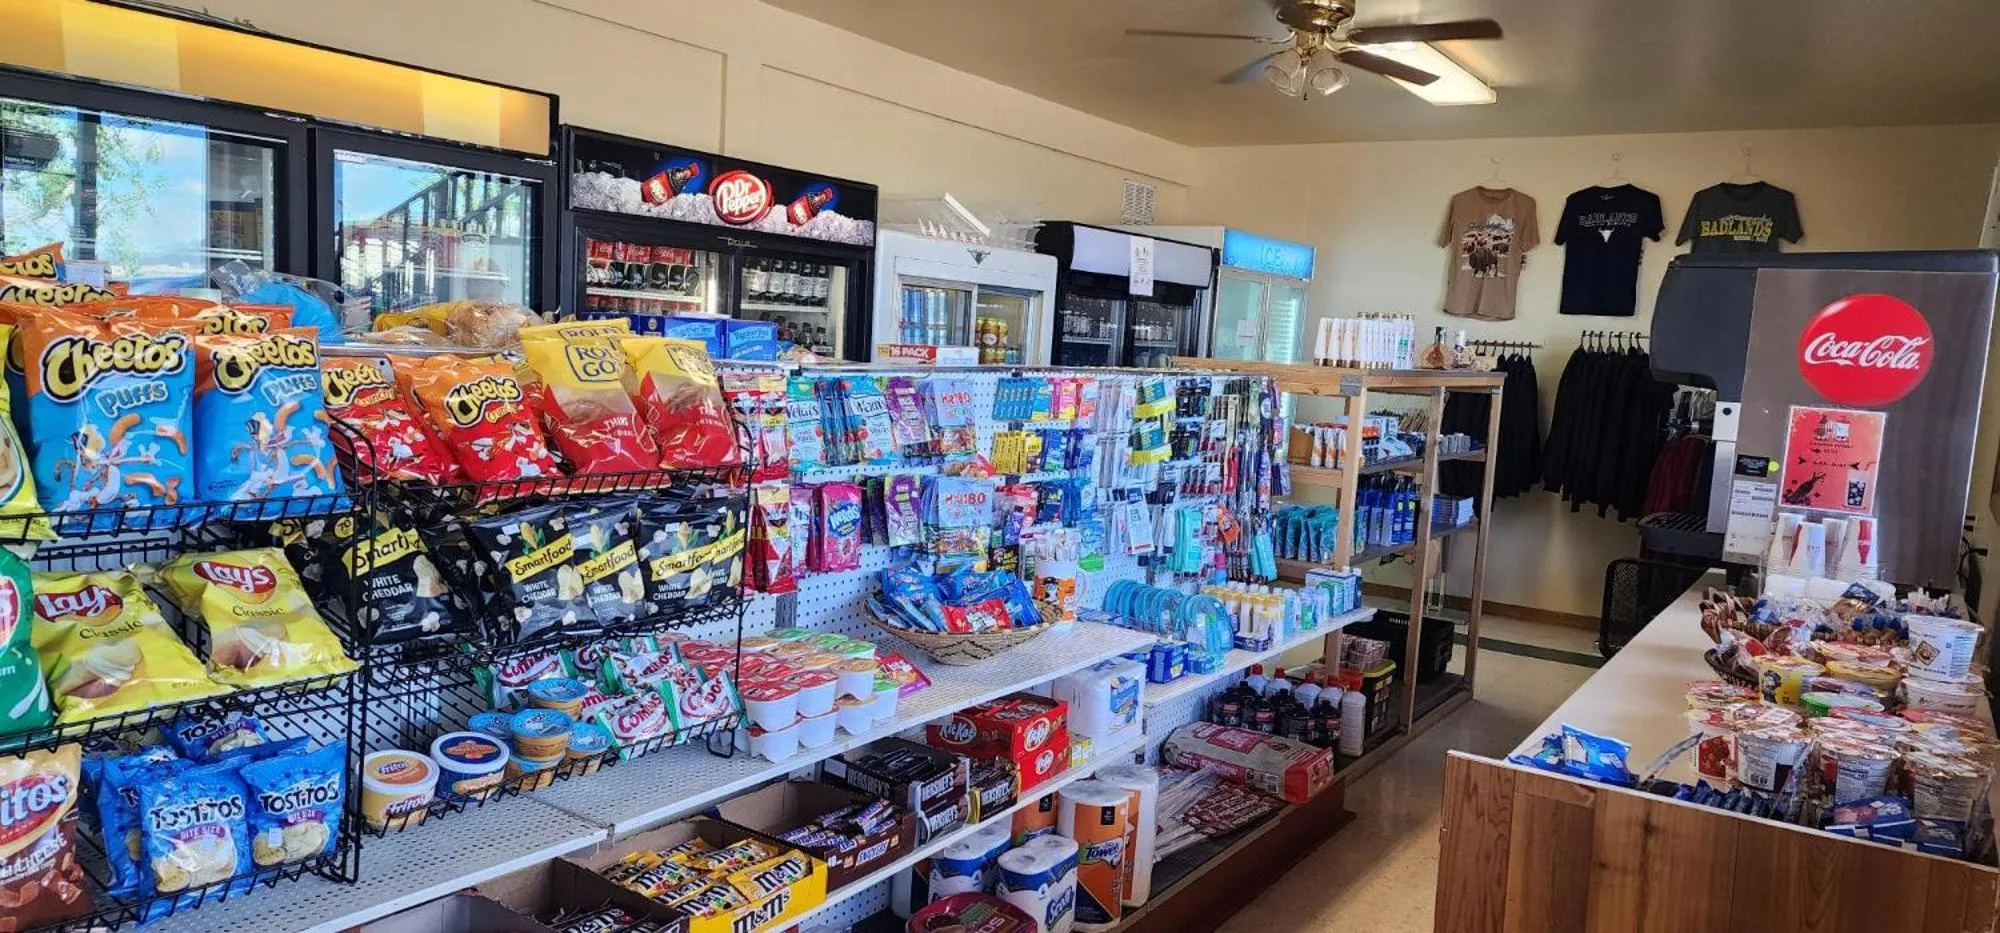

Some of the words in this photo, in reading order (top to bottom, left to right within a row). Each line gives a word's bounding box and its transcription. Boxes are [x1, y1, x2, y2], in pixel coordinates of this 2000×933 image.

[721, 184, 763, 216] Pepper
[734, 179, 751, 194] Dr
[1579, 212, 1638, 226] BADLANDS
[1700, 217, 1773, 237] BADLANDS
[0, 252, 56, 277] etos
[1260, 246, 1282, 264] ICE
[213, 338, 318, 393] Cheetos
[902, 346, 930, 359] PACK
[1804, 331, 1931, 370] Coca-Cola
[43, 335, 185, 399] Cheetos
[323, 364, 388, 407] Cheet
[447, 376, 520, 426] Cheetos
[515, 539, 572, 577] Smartfood
[585, 544, 635, 579] Smartfood
[202, 561, 272, 593] Lay's
[79, 620, 144, 640] Classic
[0, 775, 67, 826] itos
